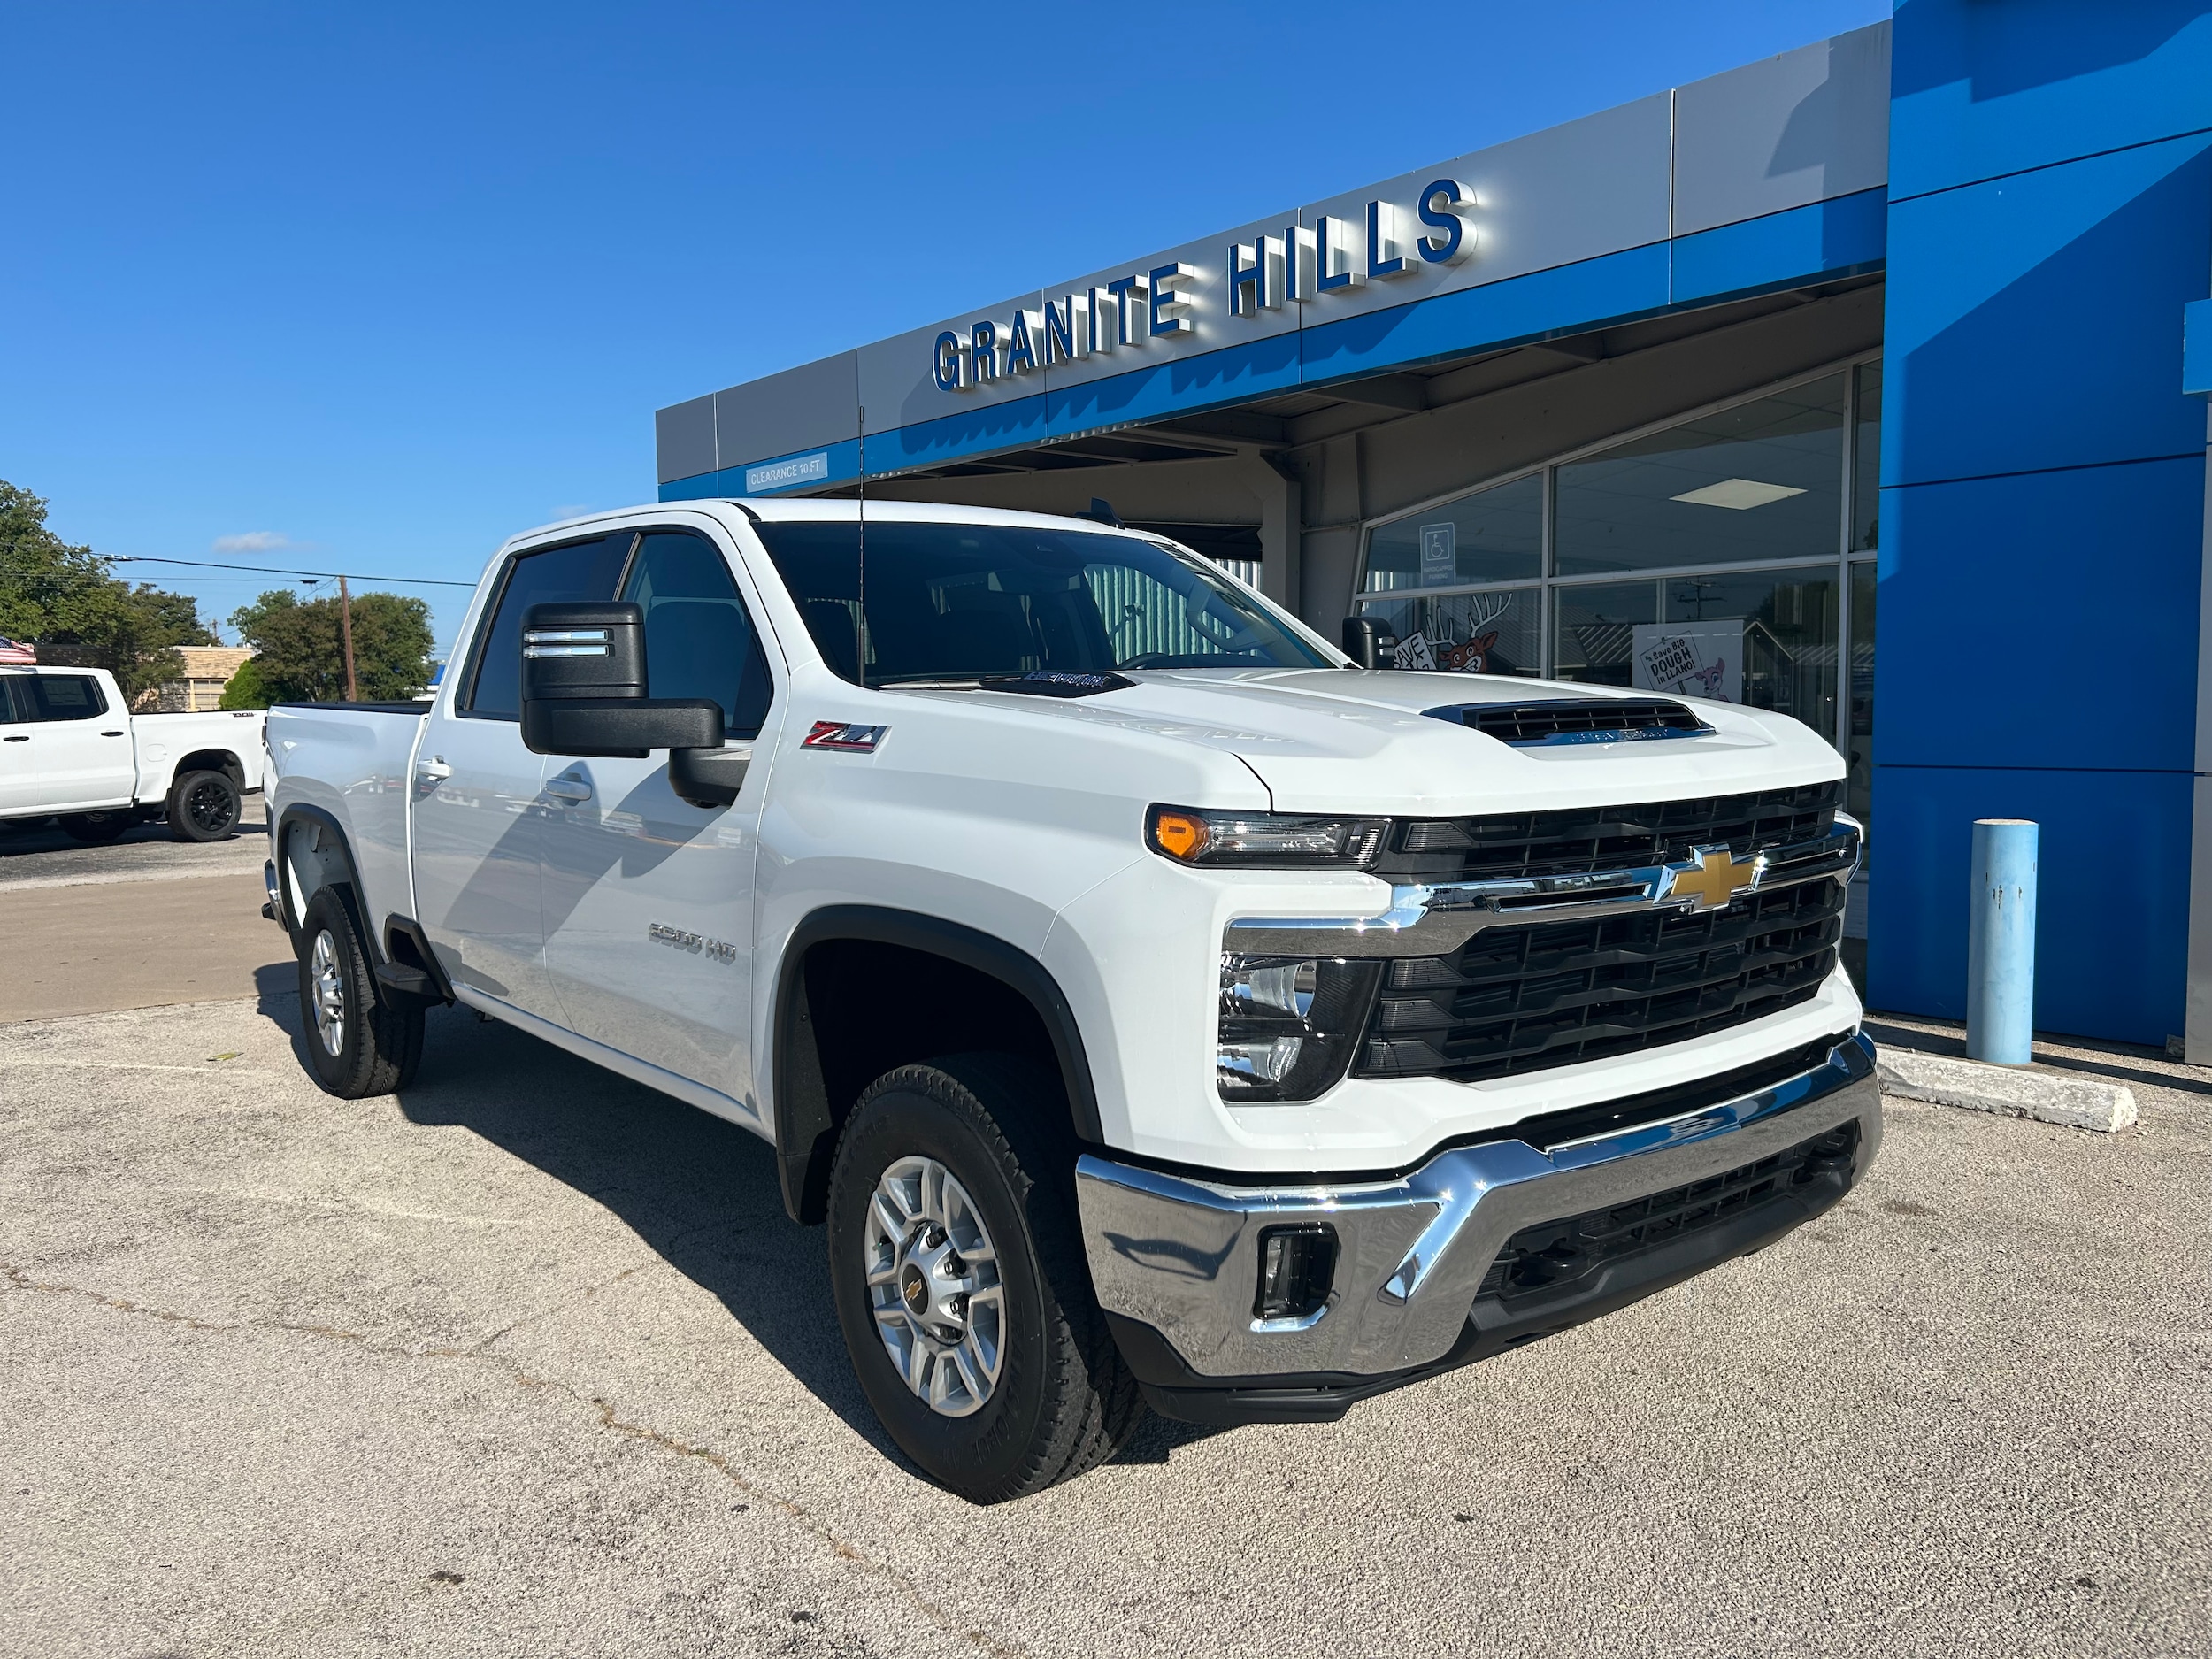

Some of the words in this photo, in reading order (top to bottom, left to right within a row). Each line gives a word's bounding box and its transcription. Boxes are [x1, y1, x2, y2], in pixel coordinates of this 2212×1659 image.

[932, 262, 1194, 393] GRANITE
[1228, 178, 1477, 319] HILLS
[750, 465, 797, 485] CLEARANCE
[800, 463, 808, 475] 10
[810, 460, 820, 472] FT
[1423, 565, 1454, 573] HANDICAPPED
[1650, 646, 1692, 677] DOUGH
[1652, 647, 1671, 660] Save
[1671, 638, 1686, 650] BIG
[1665, 659, 1696, 680] LLANO!
[649, 923, 703, 952] 2500
[705, 938, 736, 964] HD
